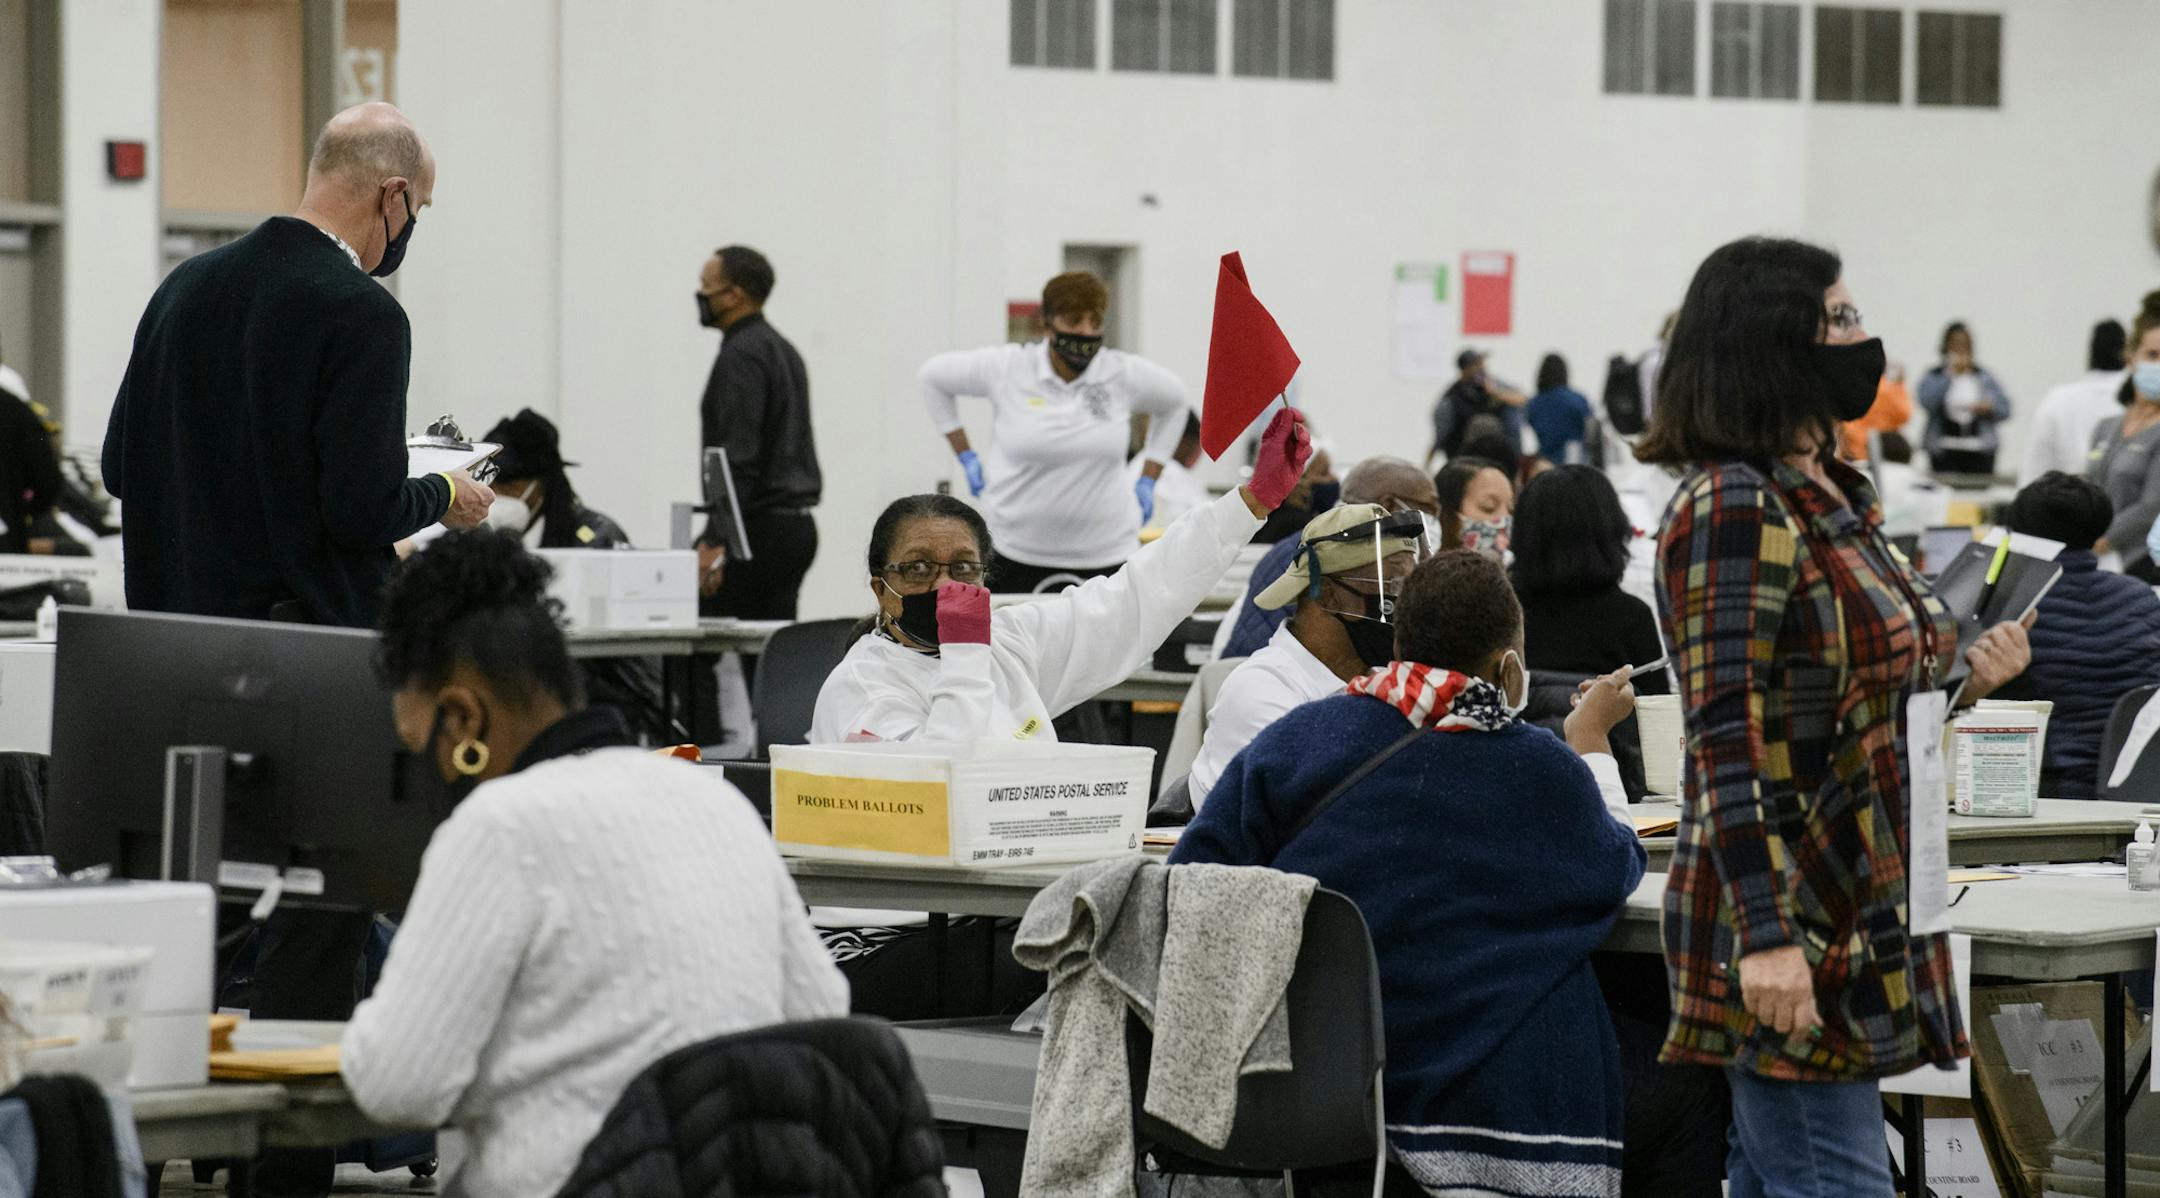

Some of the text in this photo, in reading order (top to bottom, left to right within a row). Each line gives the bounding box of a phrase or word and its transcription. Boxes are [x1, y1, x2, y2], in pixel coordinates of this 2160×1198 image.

[988, 781, 1128, 802] UNITED STATES POSTAL SERVICE
[797, 794, 924, 815] PROBLEM BALLOTS
[1946, 1137, 1963, 1154] #3
